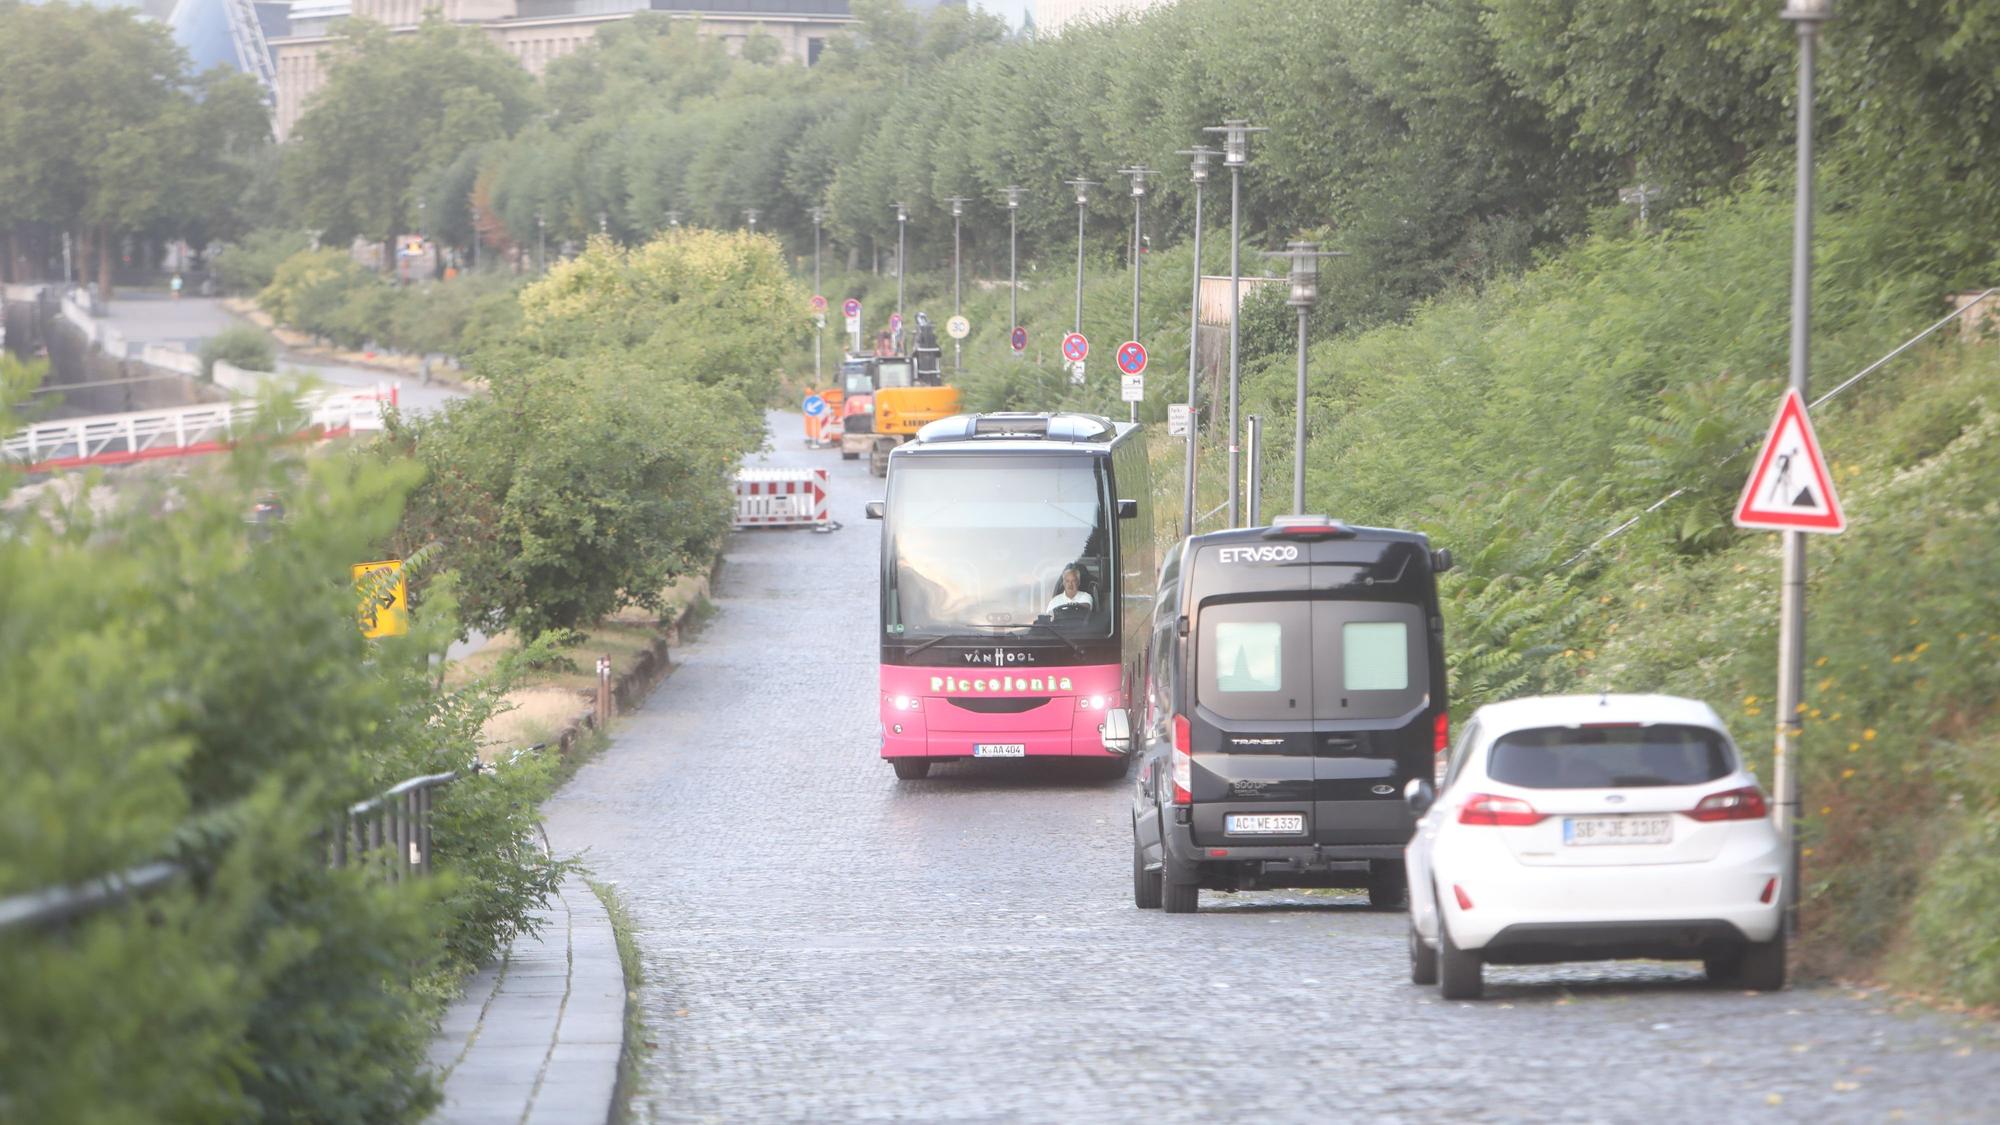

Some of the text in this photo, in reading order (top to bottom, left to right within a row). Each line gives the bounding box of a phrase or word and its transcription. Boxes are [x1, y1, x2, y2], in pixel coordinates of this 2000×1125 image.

[994, 648, 1035, 667] HOOL
[929, 675, 1073, 692] Piccolonia
[1273, 817, 1301, 829] 1337
